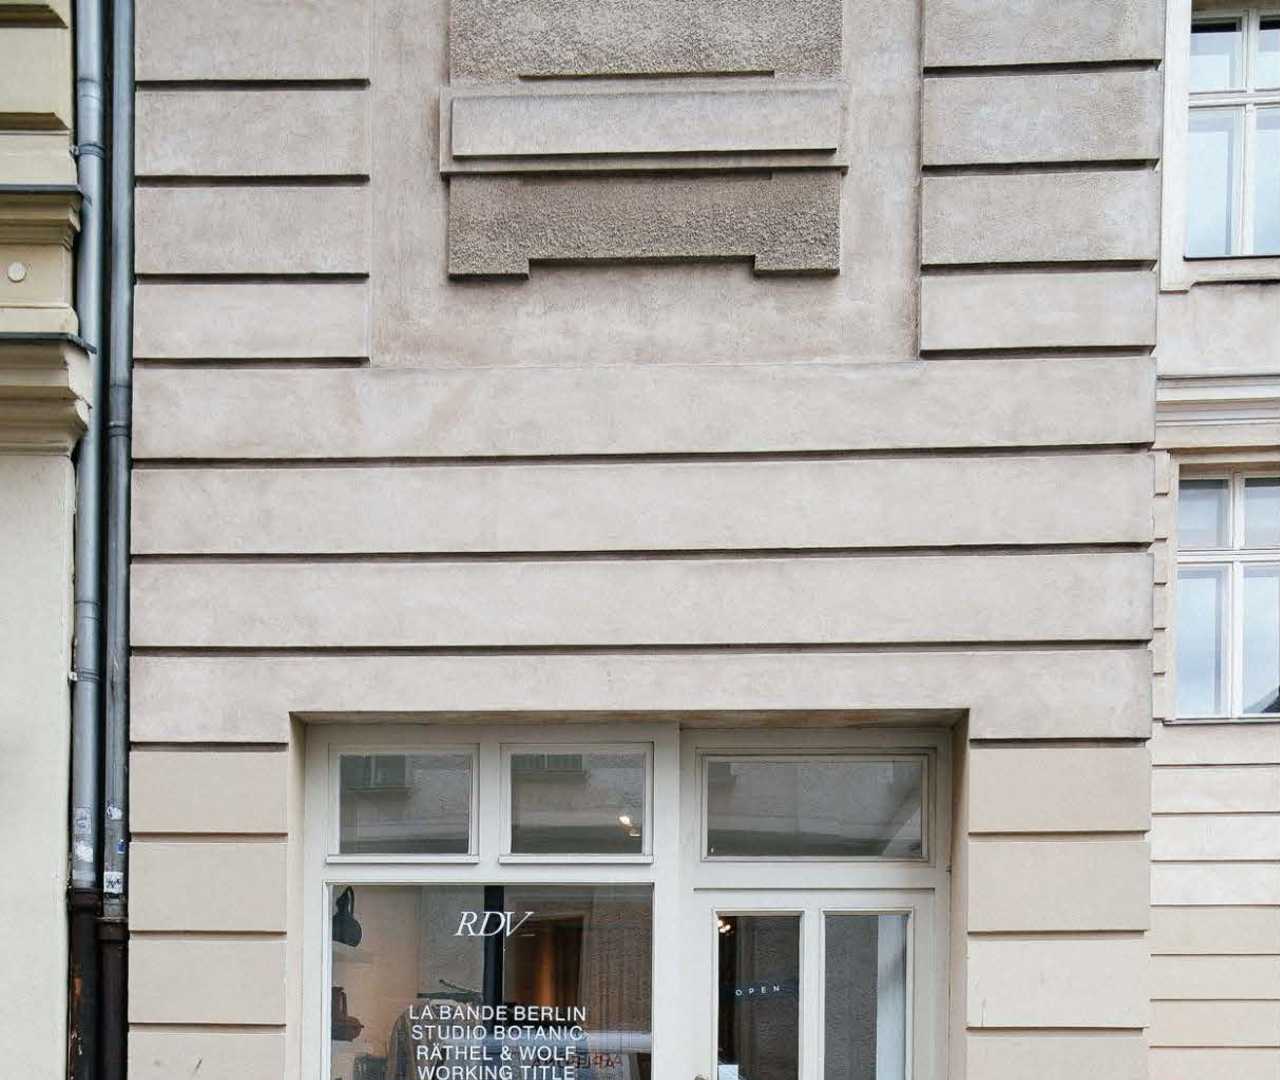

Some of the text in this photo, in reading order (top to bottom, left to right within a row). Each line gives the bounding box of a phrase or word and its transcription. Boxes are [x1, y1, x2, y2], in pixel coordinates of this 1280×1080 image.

[453, 911, 534, 937] RDV
[735, 985, 780, 996] OPEN
[409, 1005, 586, 1021] LA BANDE BERLIN
[411, 1024, 583, 1041] STUDIO BOTANIC
[416, 1042, 493, 1061] RÄTHEL
[500, 1045, 513, 1061] &
[519, 1046, 577, 1061] WOLF
[417, 1066, 576, 1080] WORKING TITLE
